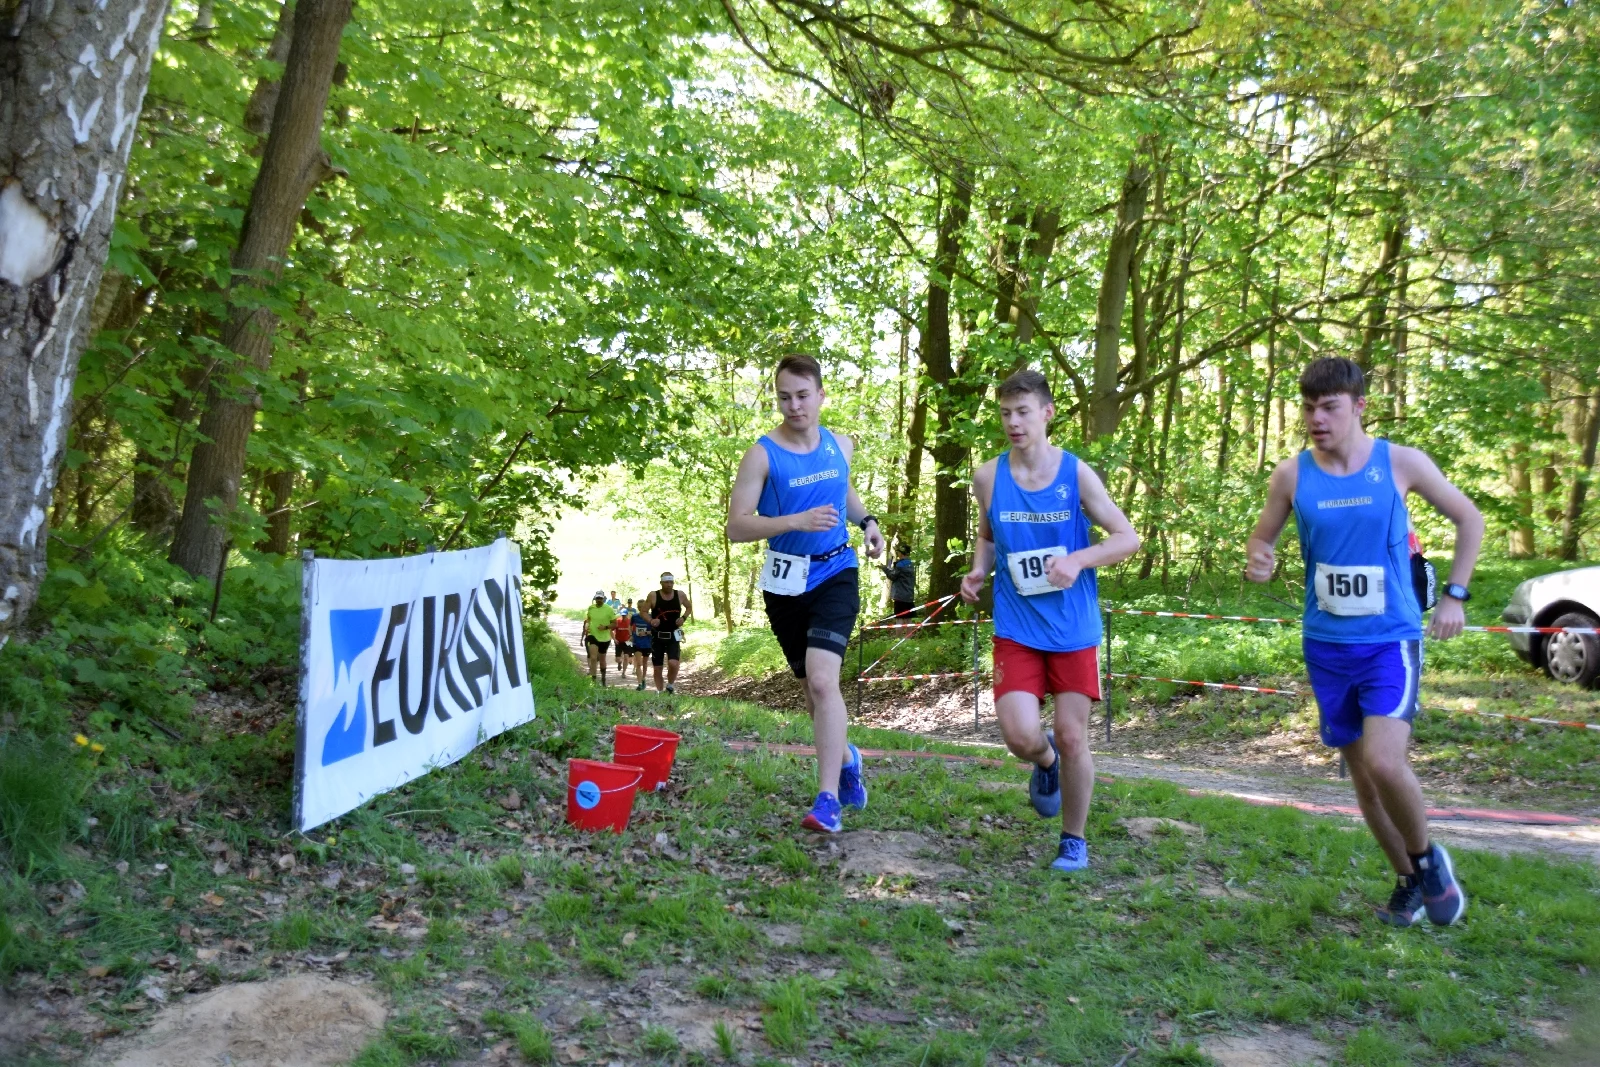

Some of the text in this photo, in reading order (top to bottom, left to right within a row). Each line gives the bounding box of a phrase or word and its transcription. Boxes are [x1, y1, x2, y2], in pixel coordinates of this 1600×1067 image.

[1323, 496, 1372, 508] EURAWASSER
[1009, 511, 1071, 523] EURAWASSER
[772, 557, 792, 580] 57
[1325, 572, 1368, 598] 150
